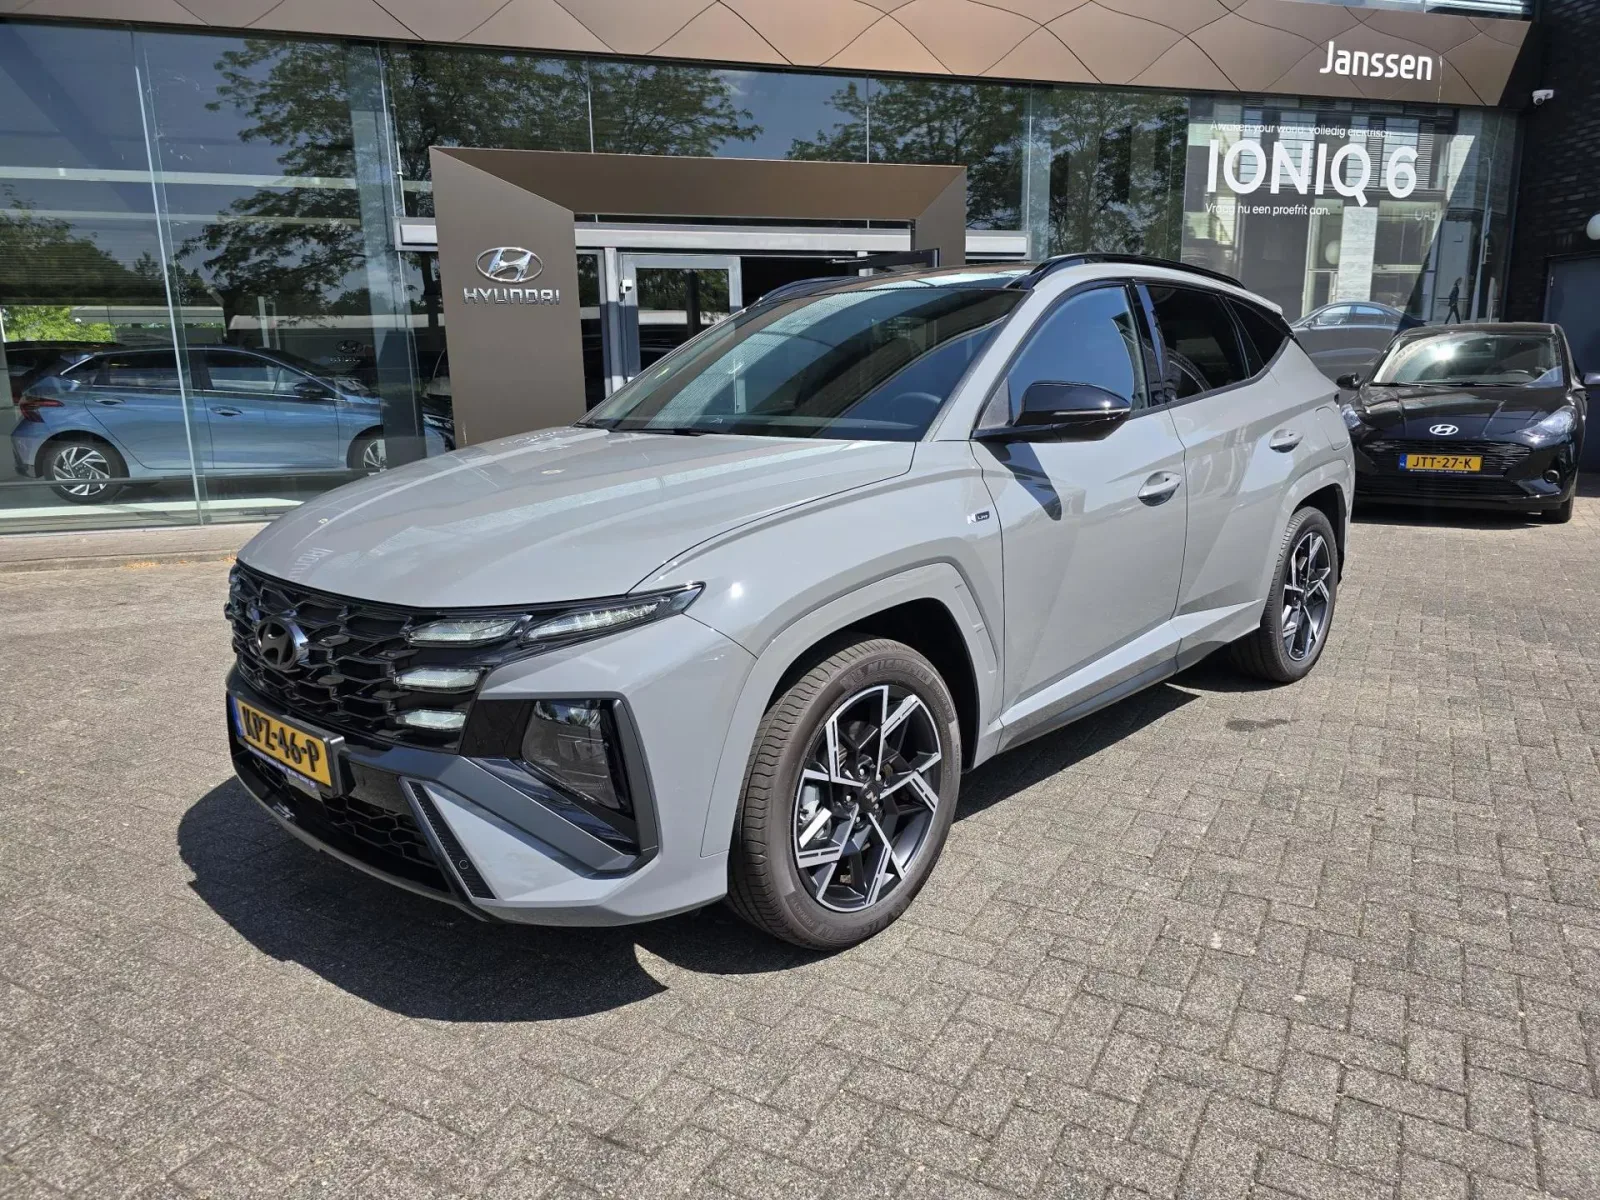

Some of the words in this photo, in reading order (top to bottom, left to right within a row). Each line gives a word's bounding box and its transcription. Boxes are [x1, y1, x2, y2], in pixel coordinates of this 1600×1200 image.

[1319, 41, 1432, 80] Janssen
[1207, 139, 1371, 207] IONIQ
[1387, 146, 1419, 198] 6
[1205, 203, 1234, 215] Vraag
[1238, 204, 1250, 214] nu
[1252, 205, 1270, 214] een
[1272, 204, 1307, 216] proefrit
[463, 287, 560, 305] HYUNDAI
[1412, 456, 1472, 469] JTT-27-K
[241, 706, 320, 772] KPZ-46-P
